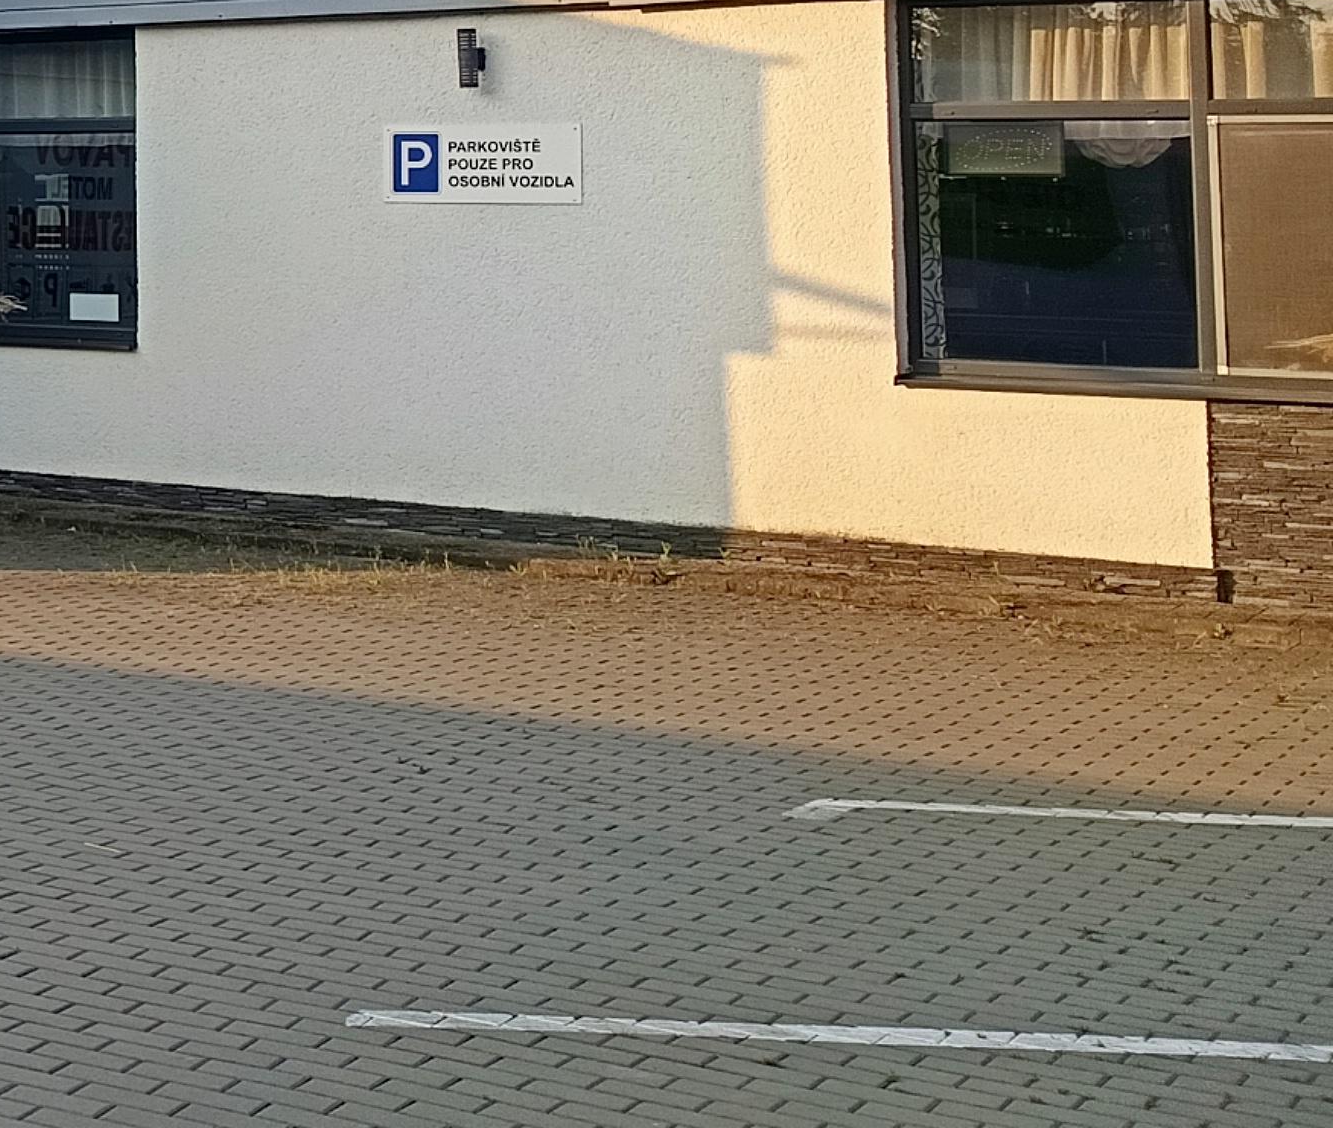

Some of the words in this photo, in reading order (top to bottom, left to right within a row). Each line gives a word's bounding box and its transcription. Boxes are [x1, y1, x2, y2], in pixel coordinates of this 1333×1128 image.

[448, 138, 541, 153] PARKOVIŠTĚ
[448, 158, 498, 170] POUZE
[502, 158, 534, 170] PRO
[448, 174, 506, 188] OSOBNÍ
[509, 176, 575, 188] VOZIDLA
